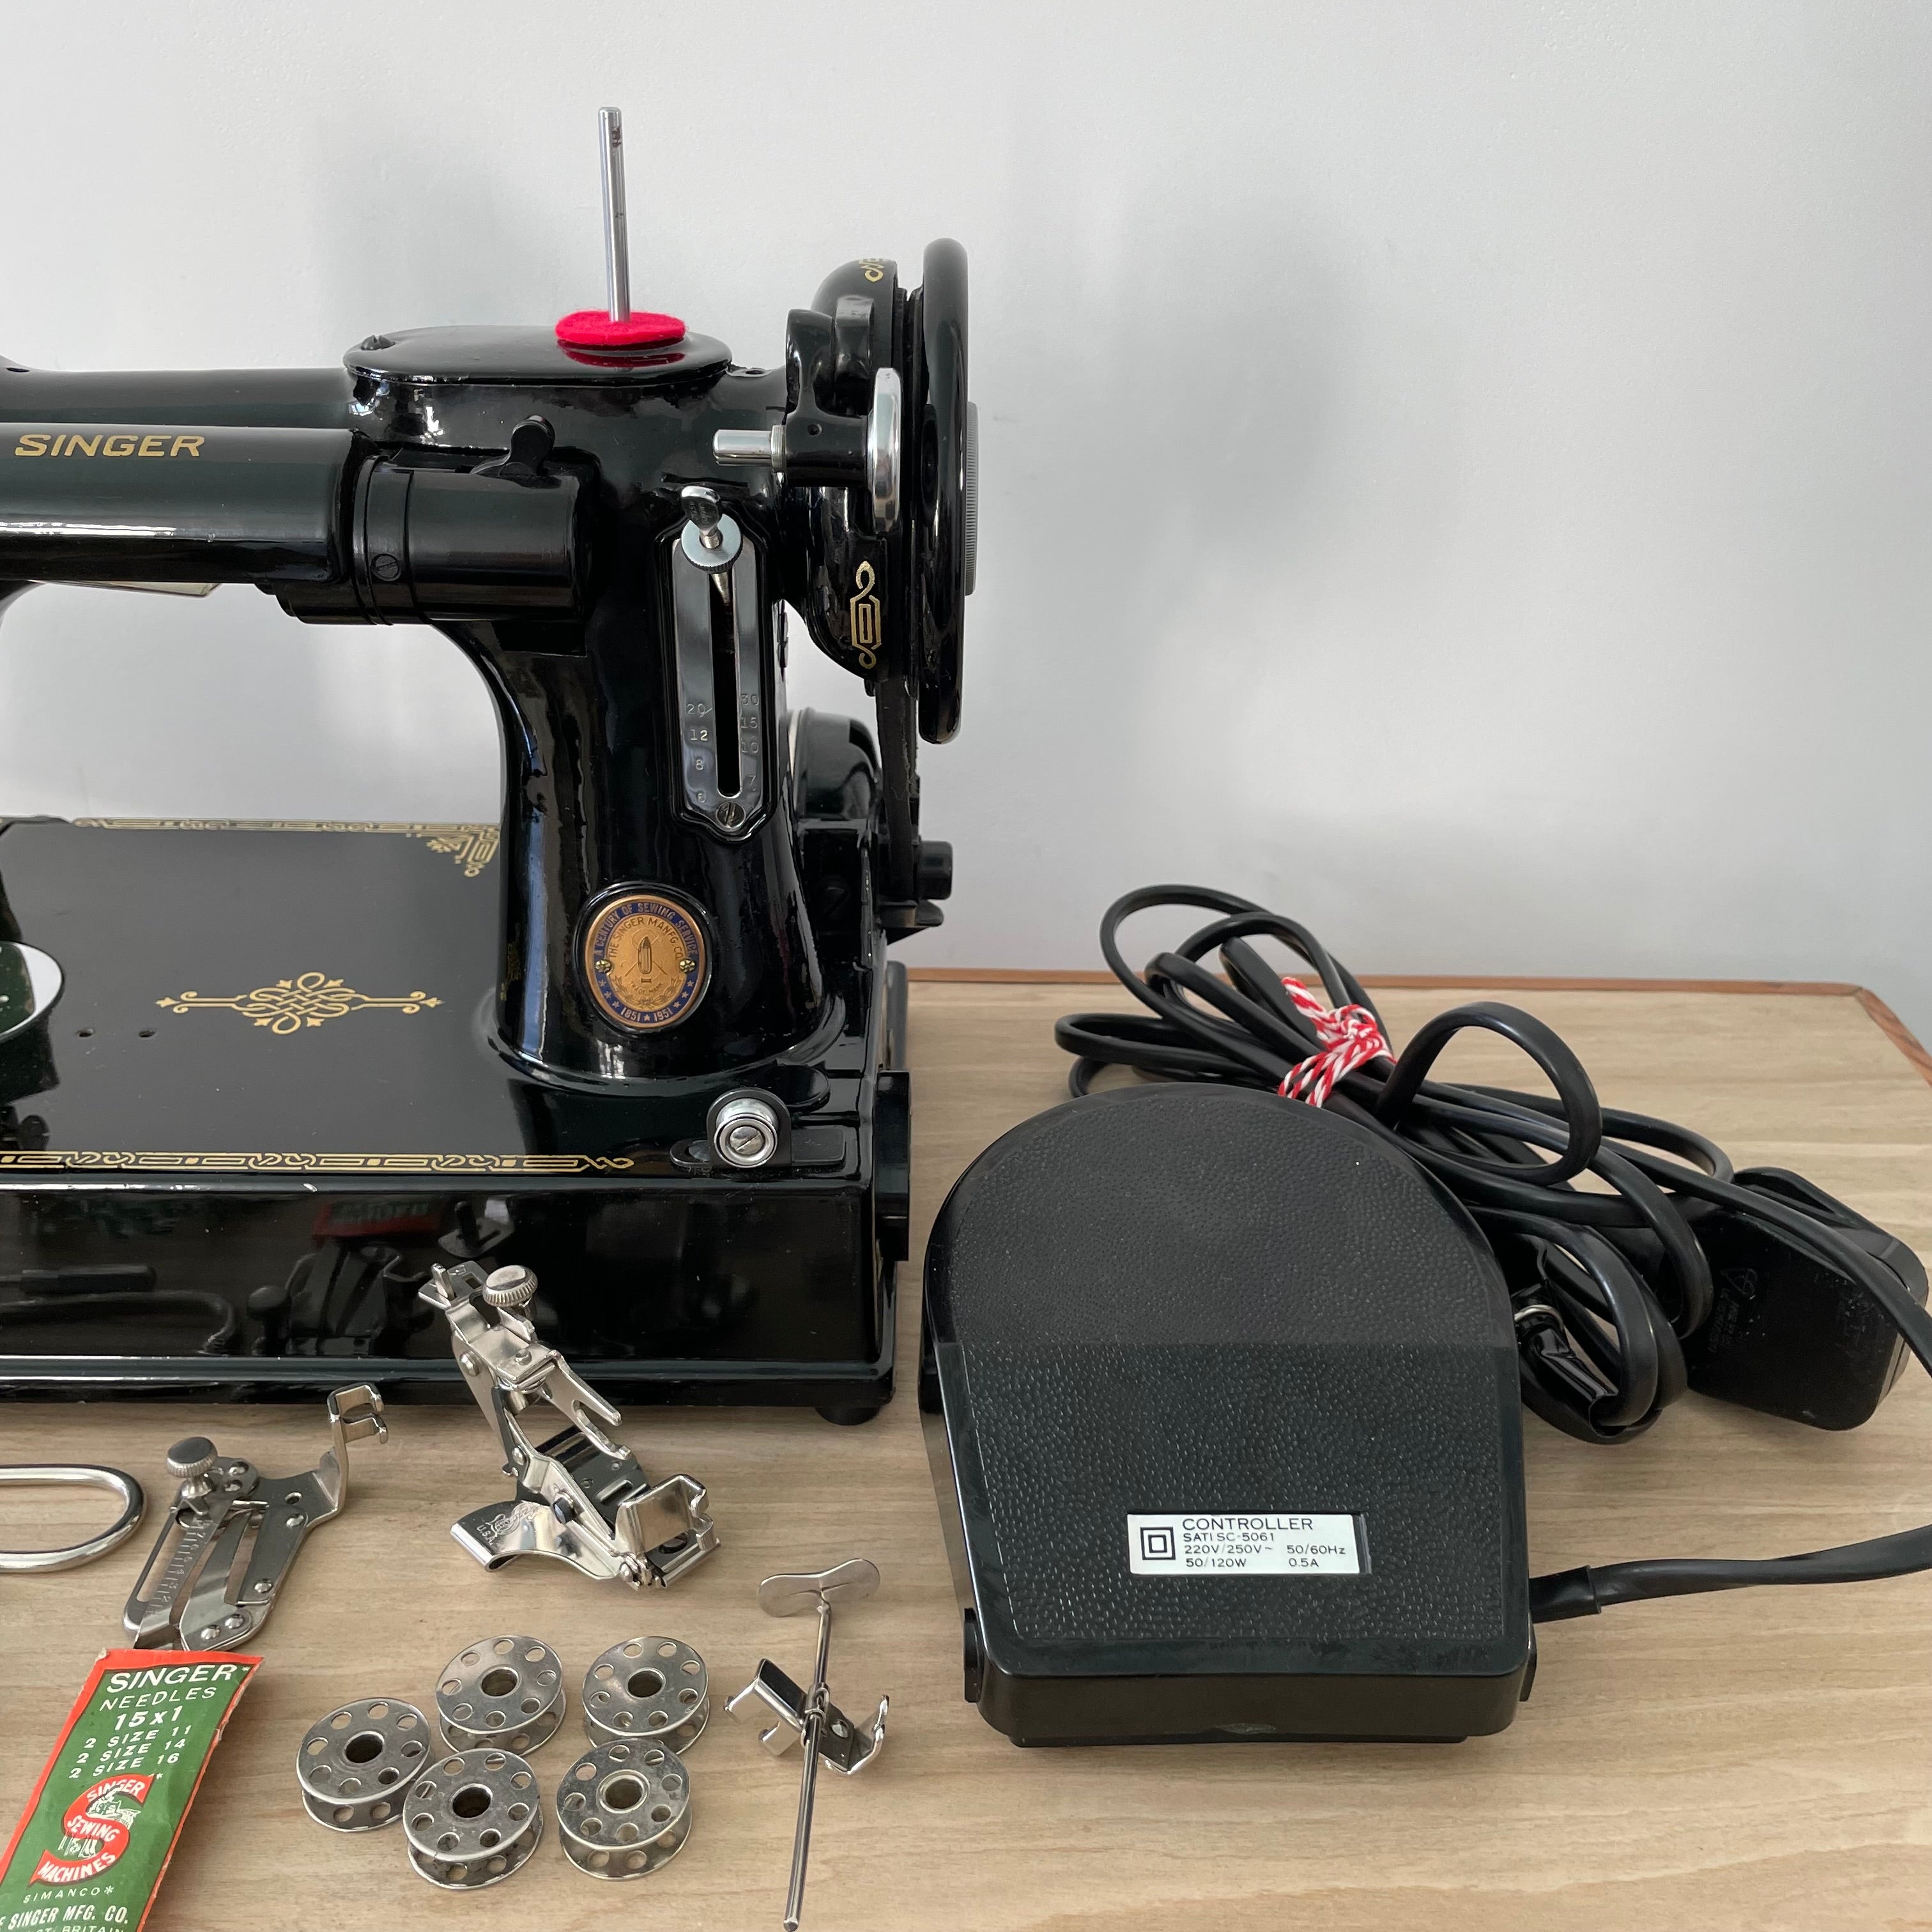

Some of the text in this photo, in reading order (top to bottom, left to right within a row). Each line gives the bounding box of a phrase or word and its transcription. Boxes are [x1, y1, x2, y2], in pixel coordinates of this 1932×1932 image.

[15, 434, 205, 457] SINGER
[740, 694, 760, 706] 30
[740, 717, 758, 729] 15
[690, 729, 709, 742] 12
[741, 742, 759, 753] 10
[695, 759, 704, 770] 8
[595, 911, 620, 947] CENTURY
[622, 904, 633, 915] OF
[638, 902, 675, 920] SEWING
[675, 920, 698, 956] SERVICE
[608, 942, 619, 958] THE
[614, 917, 645, 941] SINGER
[621, 1007, 673, 1022] 1851 1951
[1182, 1518, 1314, 1531] CONTROLLER
[1286, 1543, 1346, 1555] 50/60Hz
[1186, 1556, 1320, 1568] 50/120W 0.5A
[99, 1687, 217, 1712] NEEDLES
[84, 1724, 192, 1749] 2 SIZE 11
[76, 1738, 187, 1763] 2 SIZE 14
[68, 1752, 180, 1779] 2 SIZE 16
[86, 1779, 146, 1802] SINGER
[67, 1814, 120, 1844] SEWING
[37, 1851, 117, 1883] MACHINES
[8, 1907, 59, 1930] SINGER
[62, 1905, 96, 1922] MFG.
[104, 1905, 128, 1924] CO.
